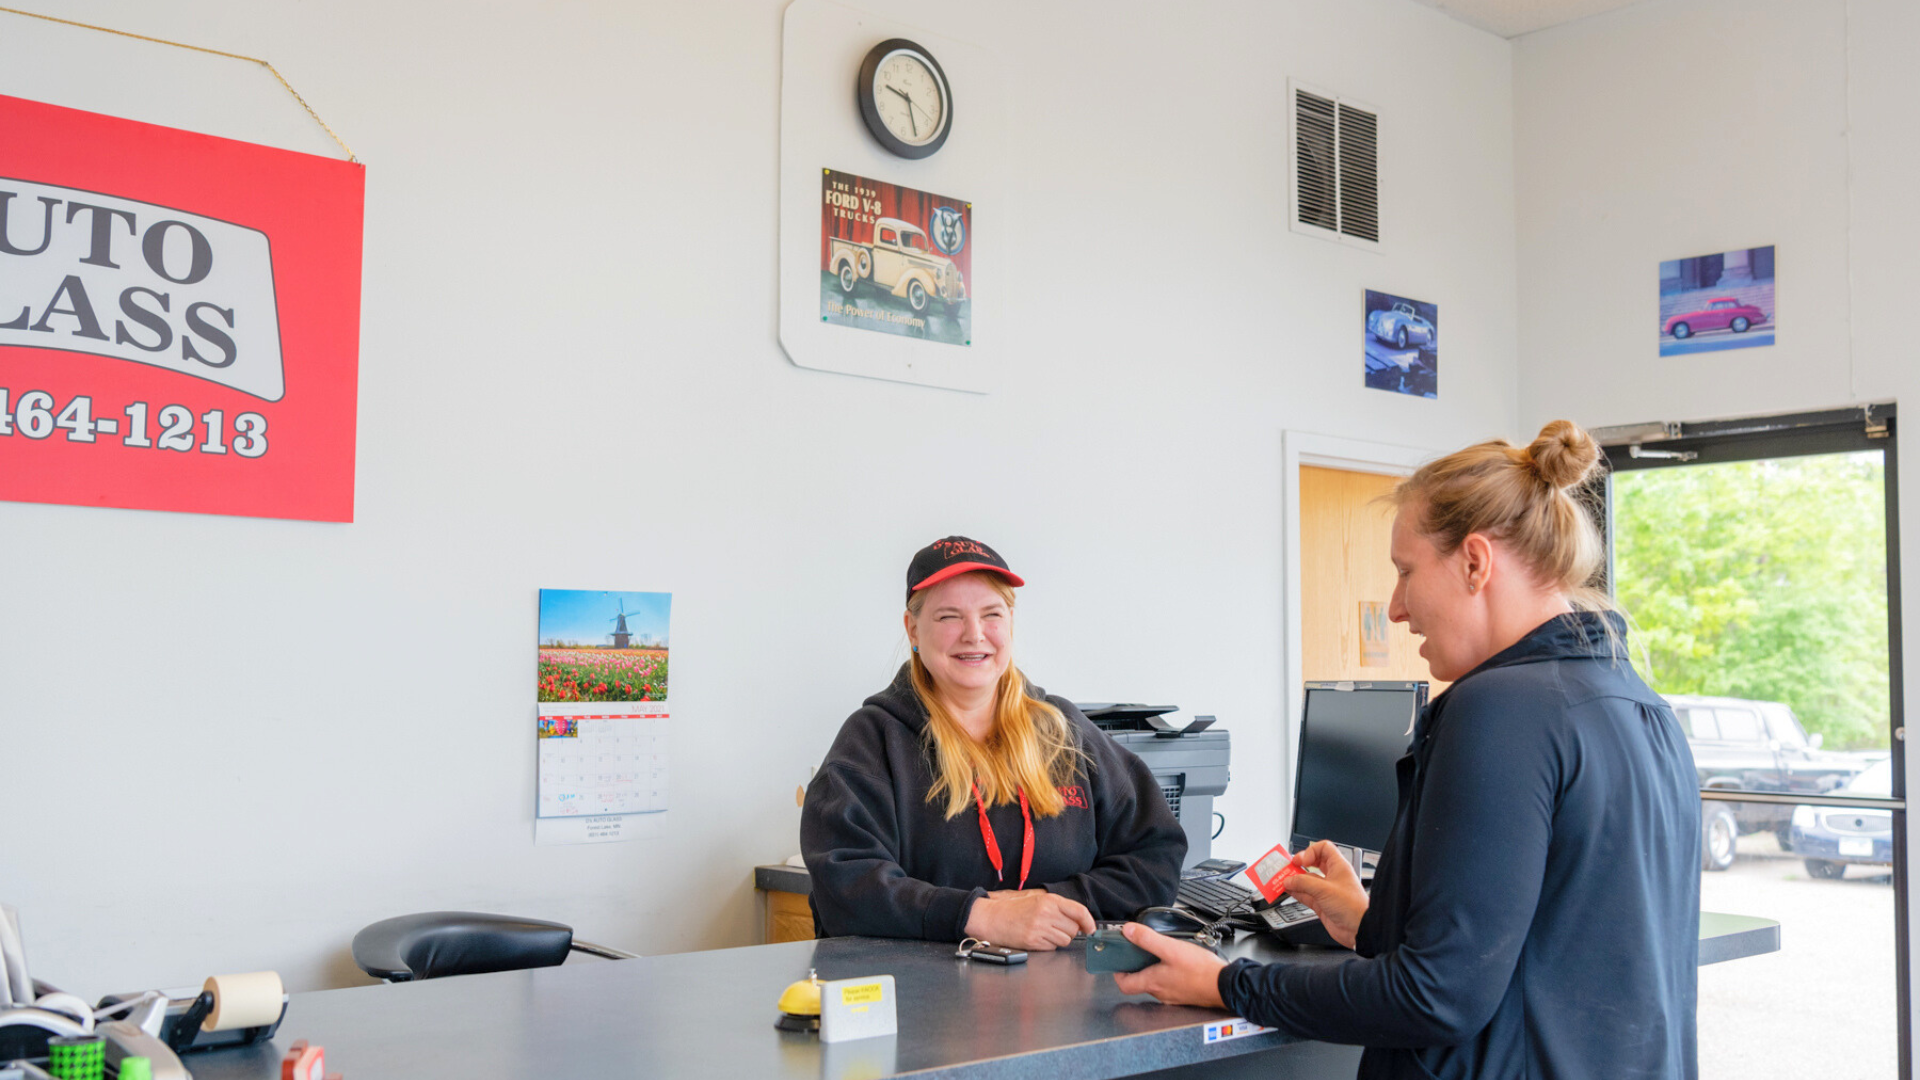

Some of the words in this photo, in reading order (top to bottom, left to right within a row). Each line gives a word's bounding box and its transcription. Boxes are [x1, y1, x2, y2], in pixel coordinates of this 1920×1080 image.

[832, 181, 850, 192] THE
[854, 186, 877, 198] 1939
[825, 189, 860, 211] FORD
[862, 198, 882, 216] V-8
[833, 207, 876, 225] TRUCKS
[827, 301, 843, 315] The
[846, 303, 874, 319] Power
[875, 309, 885, 321] of
[886, 311, 926, 330] Economy
[632, 704, 649, 713] MAY
[650, 704, 665, 713] 2021
